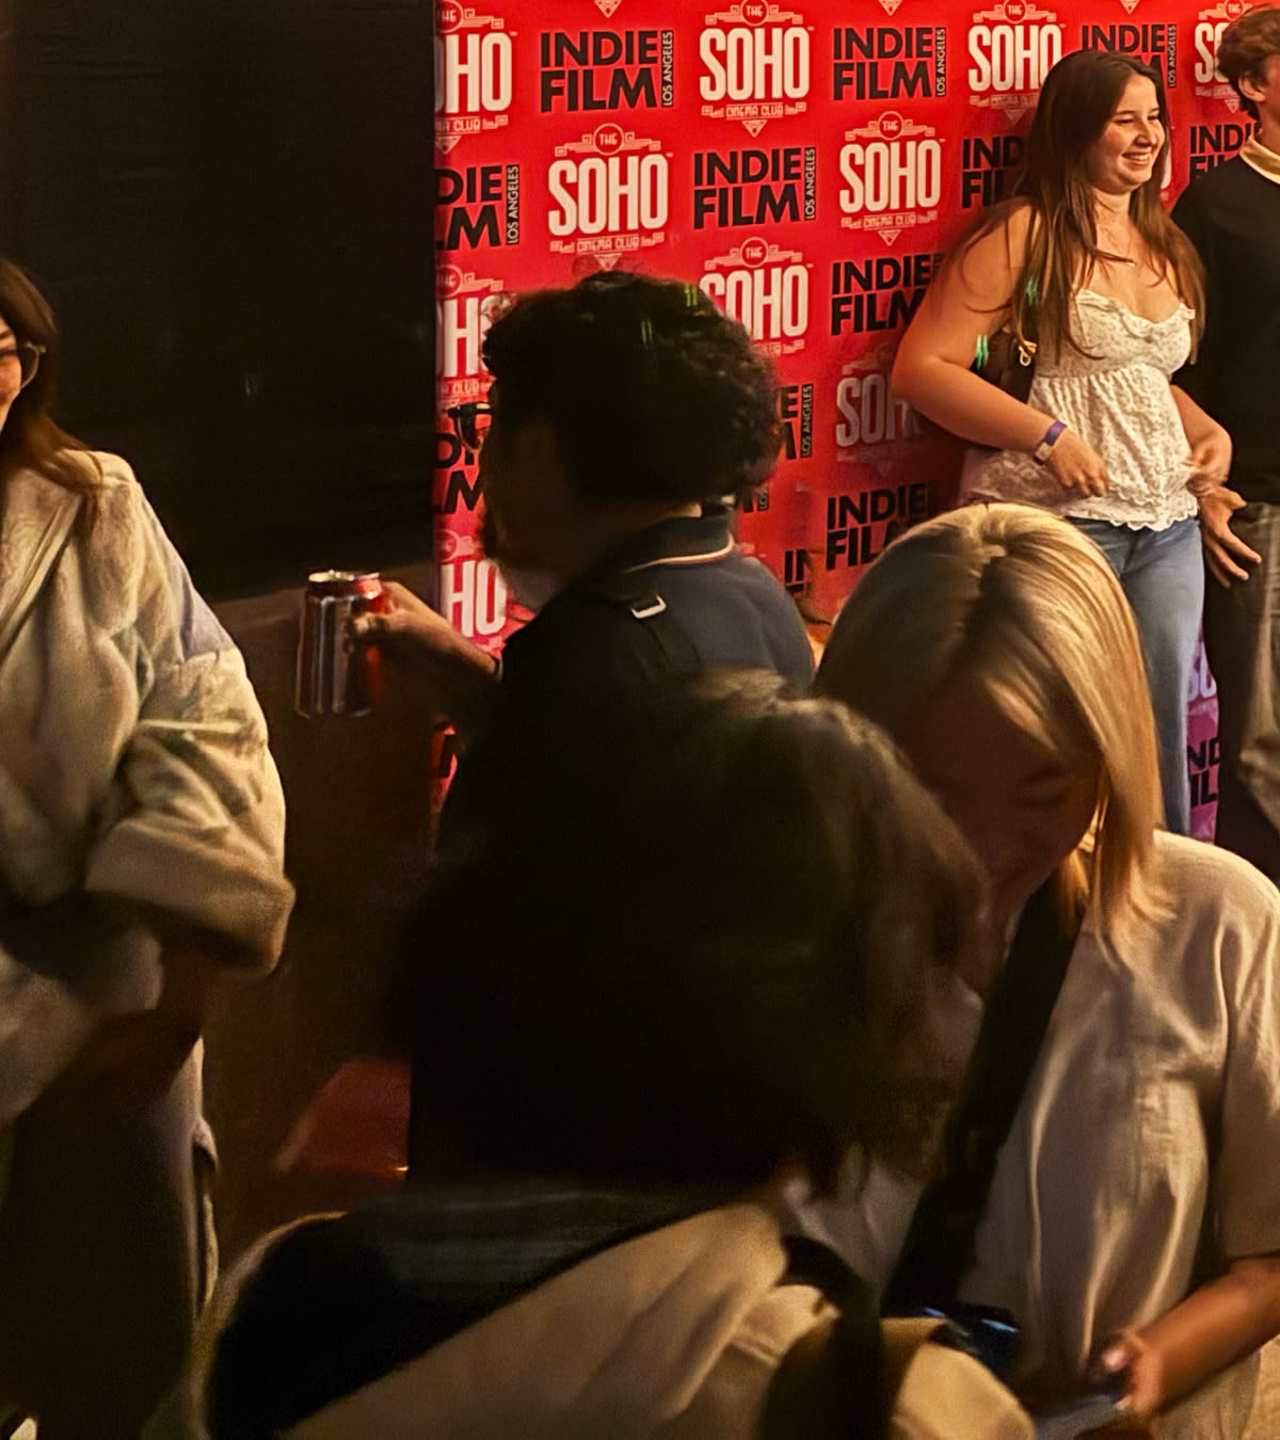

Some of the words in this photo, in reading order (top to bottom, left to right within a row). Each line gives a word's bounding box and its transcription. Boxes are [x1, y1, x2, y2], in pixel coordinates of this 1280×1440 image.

[541, 30, 658, 68] INDIE
[833, 27, 933, 60] INDIE
[968, 24, 1062, 92] SOHO
[1082, 24, 1165, 53] INDIE
[437, 32, 513, 113] HO
[699, 27, 810, 101] SOHO
[833, 61, 932, 100] FILM
[540, 67, 658, 113] FILM
[599, 133, 617, 146] THE
[435, 166, 503, 204] DIE
[693, 147, 802, 187] INDIE
[839, 139, 942, 213] SOHO
[548, 153, 669, 237] SOHO
[693, 183, 801, 230] FILM
[832, 253, 931, 295] INDIE
[443, 559, 507, 638] HO
